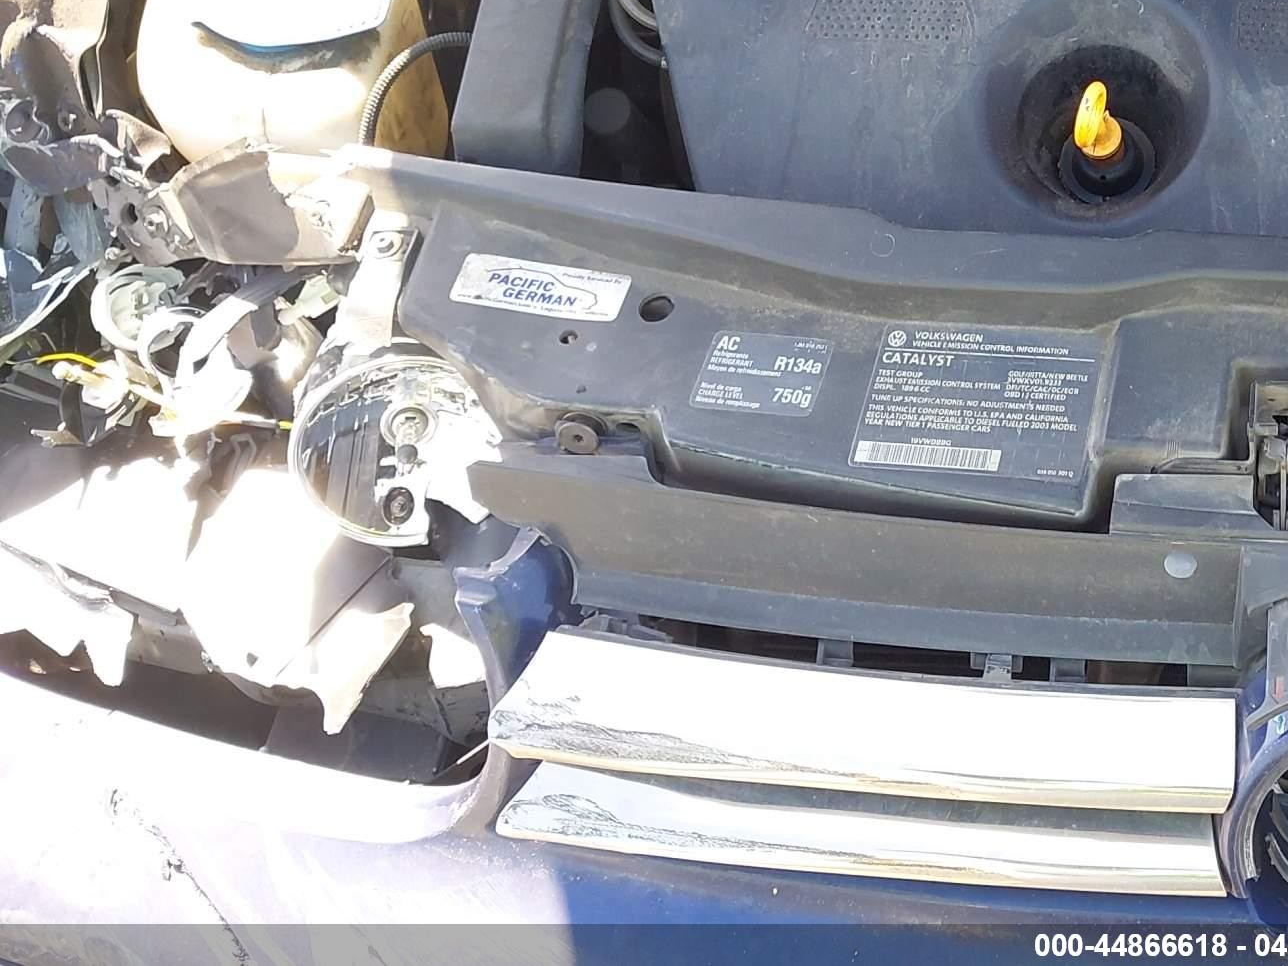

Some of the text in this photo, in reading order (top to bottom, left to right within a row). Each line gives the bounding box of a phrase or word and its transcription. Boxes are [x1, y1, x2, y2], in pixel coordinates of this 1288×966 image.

[487, 272, 555, 293] PACIFIC
[502, 287, 578, 307] GERMAN
[716, 335, 741, 351] AC
[915, 330, 984, 343] VOLKSWAGEN
[912, 340, 1069, 355] VEHICLE EMISSION CONTROL INFORMATION
[774, 355, 822, 374] R134a
[882, 351, 955, 367] CATALYST
[879, 369, 924, 378] TEST GROUP
[1066, 373, 1088, 382] BEETLE
[873, 383, 931, 393] DISPL. 1896 CC
[875, 376, 1001, 391] EXHAUST EMISSION CONTROL SYSTEM
[698, 388, 725, 398] CHARGE
[772, 387, 812, 408] 750g
[1030, 392, 1067, 401] CERTIFIED
[871, 394, 892, 402] TUNE
[904, 396, 965, 406] SPECIFICATIONS:
[981, 400, 1035, 411] ADJUSTMENTS
[1035, 403, 1065, 412] NEEDED
[866, 411, 918, 421] REGULATIONS
[918, 414, 962, 424] APPLICABLE
[975, 418, 1001, 427] DIESEL
[1030, 421, 1049, 430] 2003
[1050, 423, 1078, 432] MODEL
[886, 405, 917, 413] VEHICLE
[917, 406, 961, 416] CONFORMS
[990, 411, 1005, 419] EPA
[1024, 414, 1069, 423] CALIFORNIA
[864, 418, 883, 426] YEAR
[885, 419, 903, 427] NEW
[905, 420, 920, 428] TIER
[926, 422, 970, 432] PASSENGER
[971, 425, 991, 433] CARS
